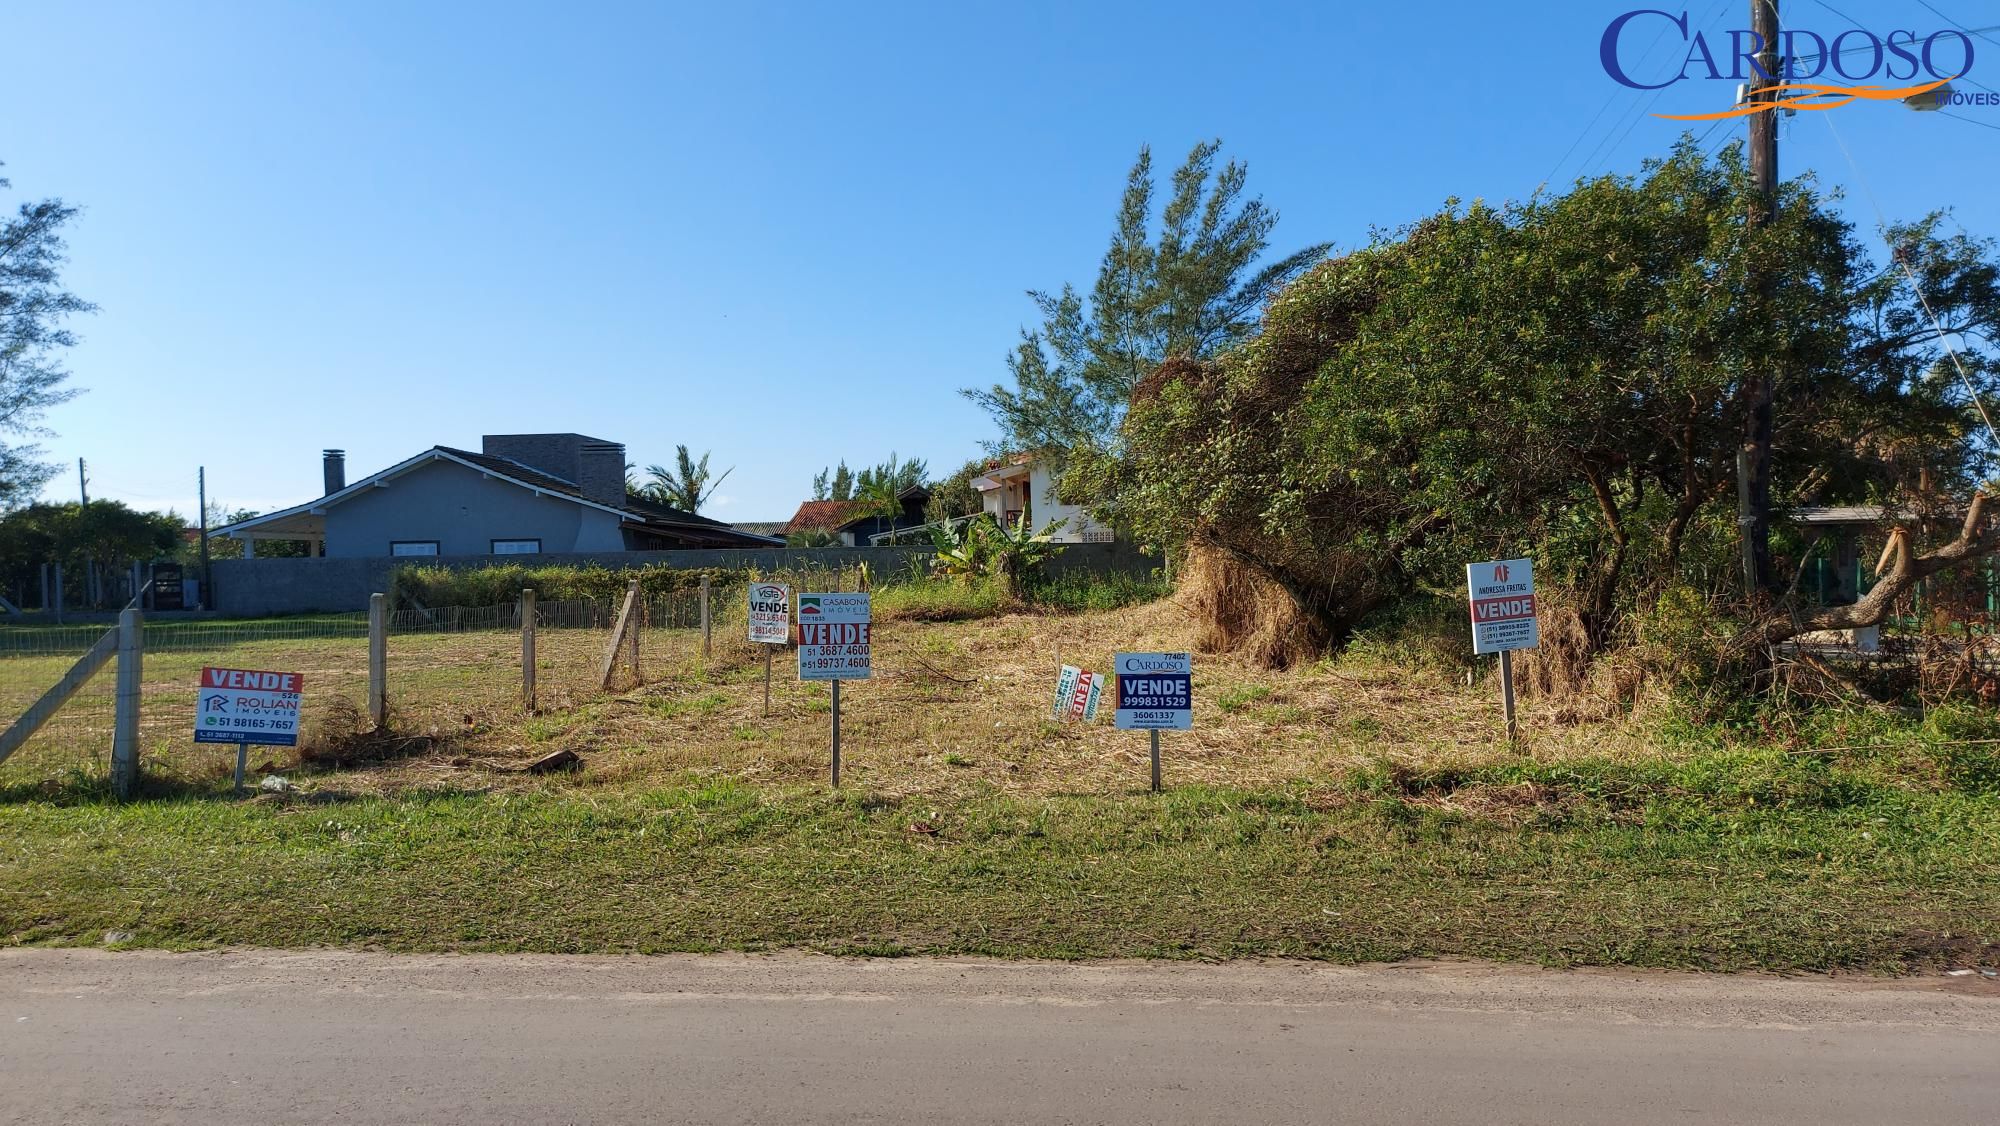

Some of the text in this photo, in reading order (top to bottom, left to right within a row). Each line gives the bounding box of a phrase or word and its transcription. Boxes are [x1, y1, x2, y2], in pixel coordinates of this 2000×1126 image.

[1478, 585, 1505, 595] ANDRESSA
[1506, 583, 1527, 593] FREITAS
[750, 602, 788, 613] VENDE
[823, 598, 869, 606] CASABONA
[823, 605, 869, 613] IMÓVEIS
[1477, 599, 1532, 618] VENDE
[803, 624, 869, 644] VENDE
[807, 645, 870, 656] 51 3687.4600
[817, 658, 870, 669] 99737.4600
[1126, 658, 1183, 671] CARDOSO
[210, 669, 295, 691] VENDE
[1124, 679, 1187, 695] VENDE
[236, 697, 298, 710] ROLIAN
[1124, 697, 1186, 706] 999831529
[235, 708, 296, 717] IMÓVEIS
[1133, 711, 1175, 719] 36061337
[218, 717, 294, 730] 51 98165-7657
